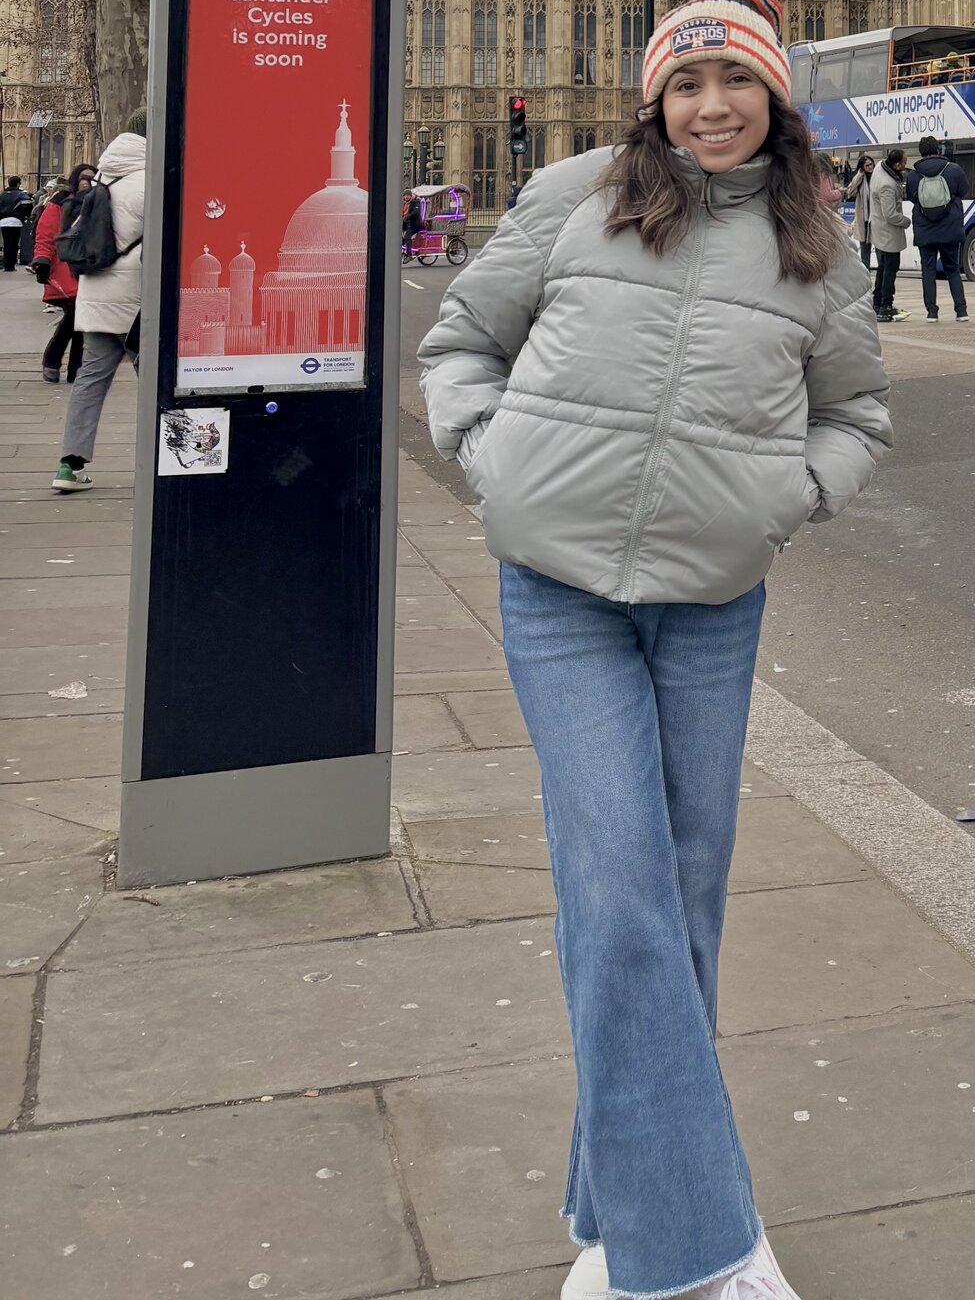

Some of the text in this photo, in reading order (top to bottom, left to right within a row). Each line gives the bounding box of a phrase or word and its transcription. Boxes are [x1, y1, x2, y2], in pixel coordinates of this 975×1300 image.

[247, 7, 314, 27] Cycles
[679, 19, 717, 31] HOUSTON
[232, 28, 328, 49] is coming
[674, 28, 725, 46] ASTROS
[254, 53, 304, 67] soon
[866, 92, 945, 117] HOP-ON HOP-OFF
[898, 114, 945, 135] LONDON
